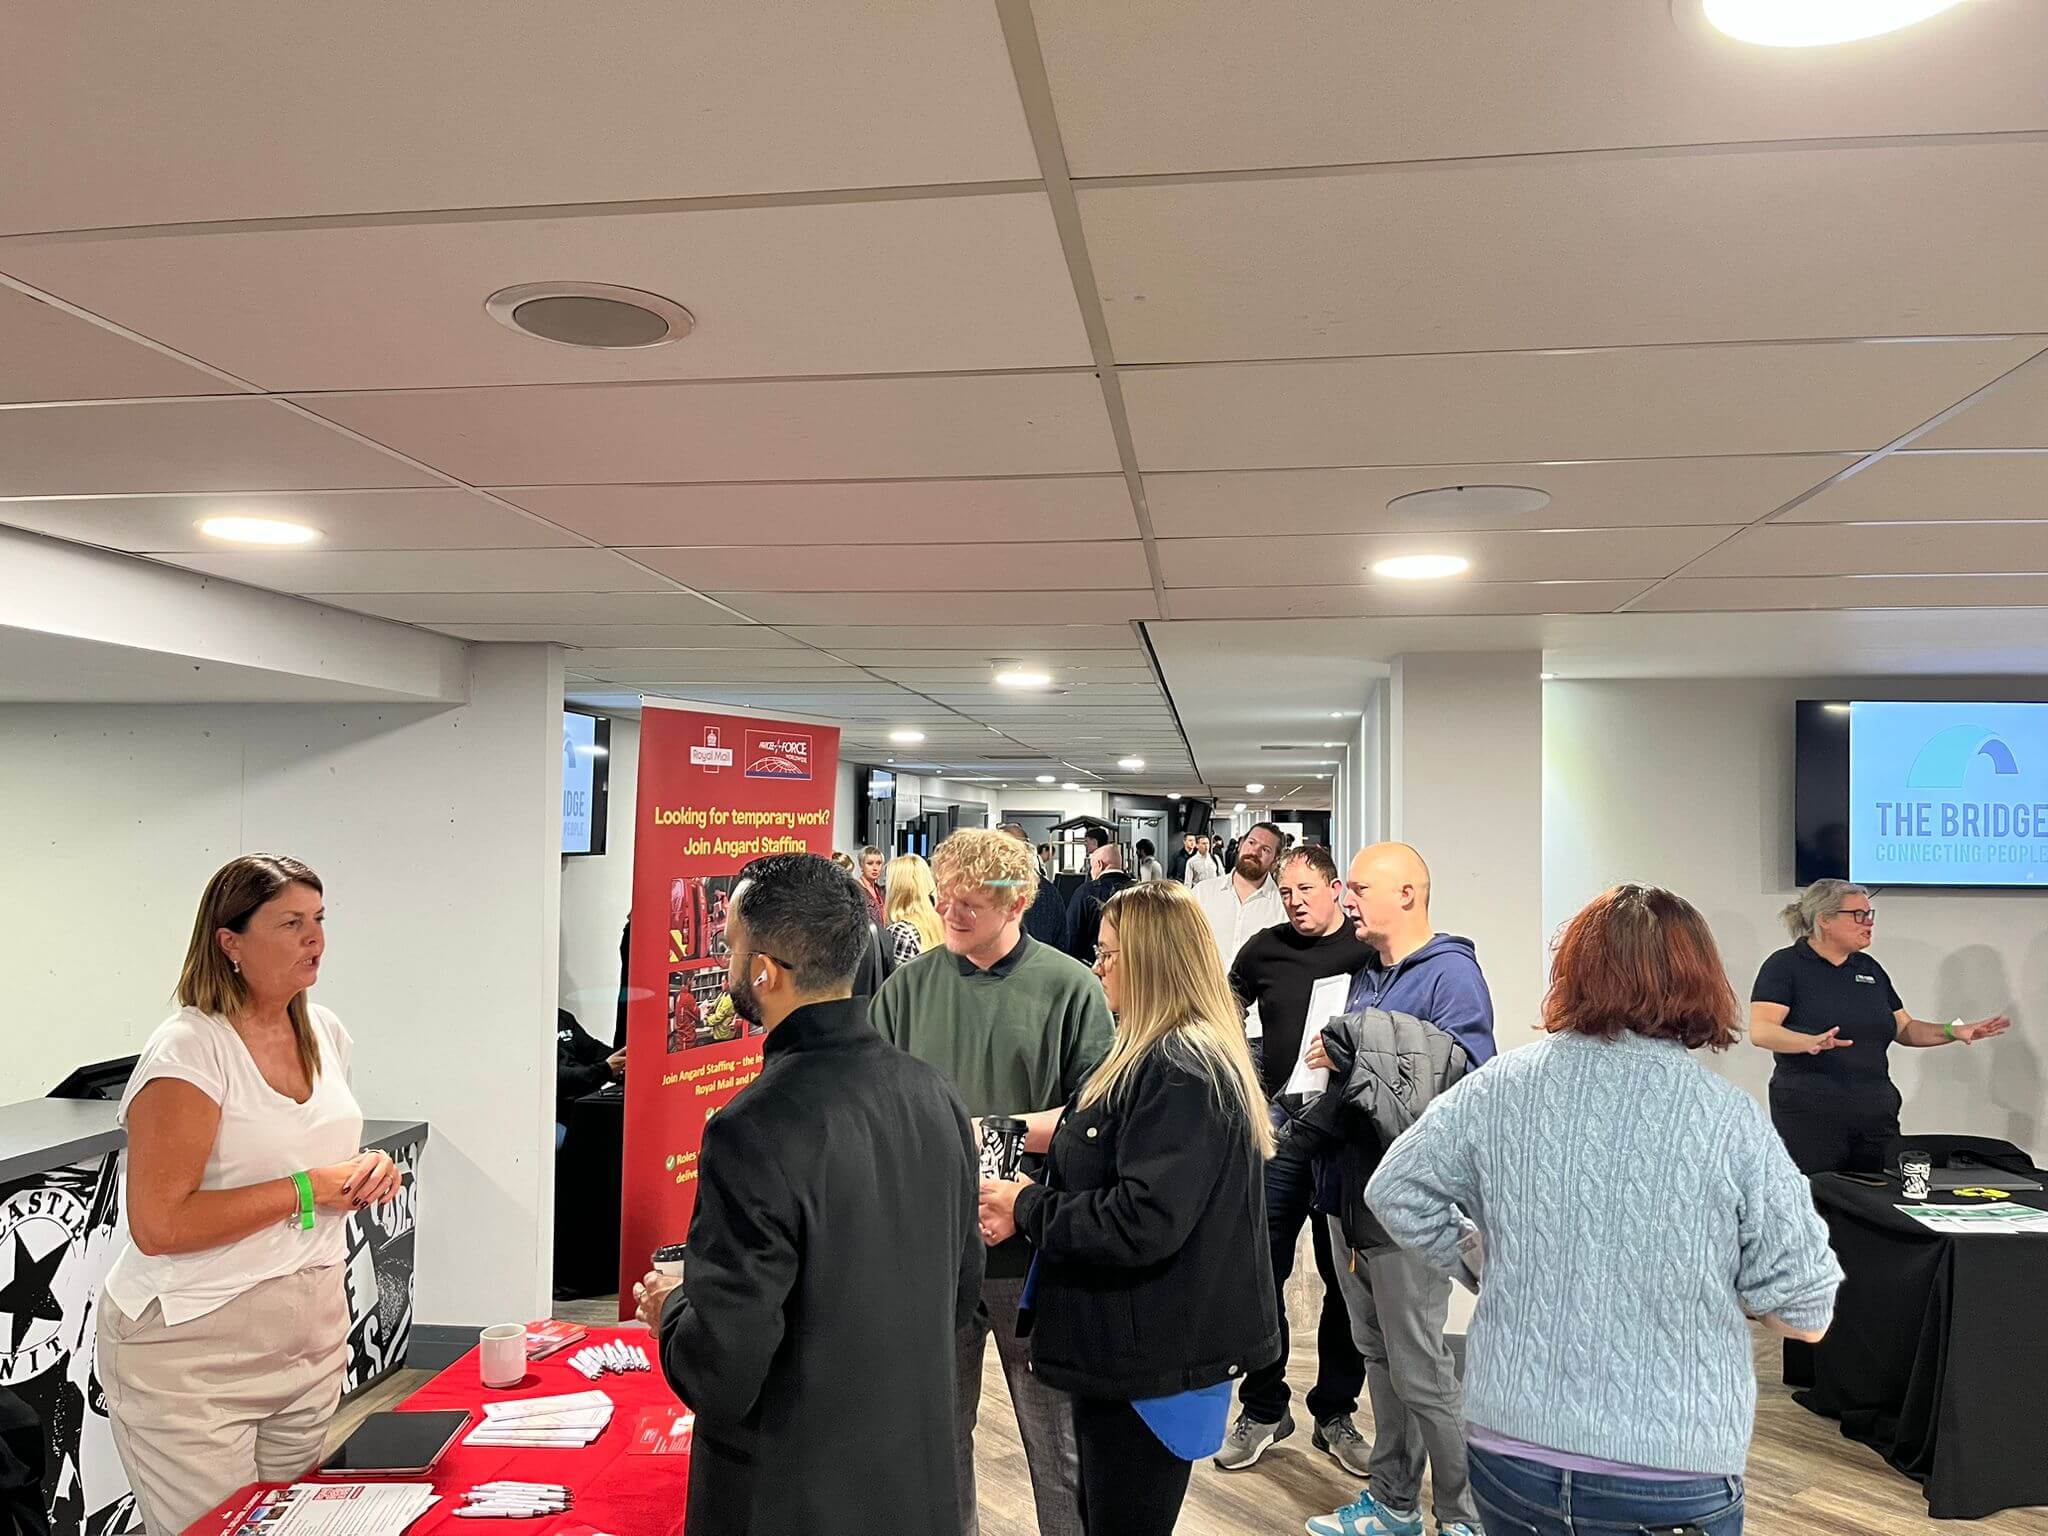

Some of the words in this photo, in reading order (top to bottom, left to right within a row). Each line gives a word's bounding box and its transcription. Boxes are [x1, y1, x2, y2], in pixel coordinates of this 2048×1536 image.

[655, 806, 707, 829] Looking
[709, 806, 729, 825] for
[732, 809, 795, 829] temporary
[797, 809, 831, 826] work?
[1875, 802, 1932, 837] THE
[1941, 802, 2048, 838] BRIDGE
[683, 837, 711, 855] Join
[713, 836, 759, 858] Angard
[761, 836, 807, 853] Staffing
[1875, 844, 1981, 864] CONNECTING
[1987, 845, 2048, 864] PEOPLE
[661, 1074, 679, 1087] Join
[679, 1064, 706, 1082] Angard
[706, 1059, 736, 1075] Staffing
[742, 1055, 754, 1067] the
[695, 1080, 716, 1096] Royal
[717, 1076, 734, 1089] Mail
[735, 1073, 749, 1086] and
[676, 1151, 697, 1165] Roles
